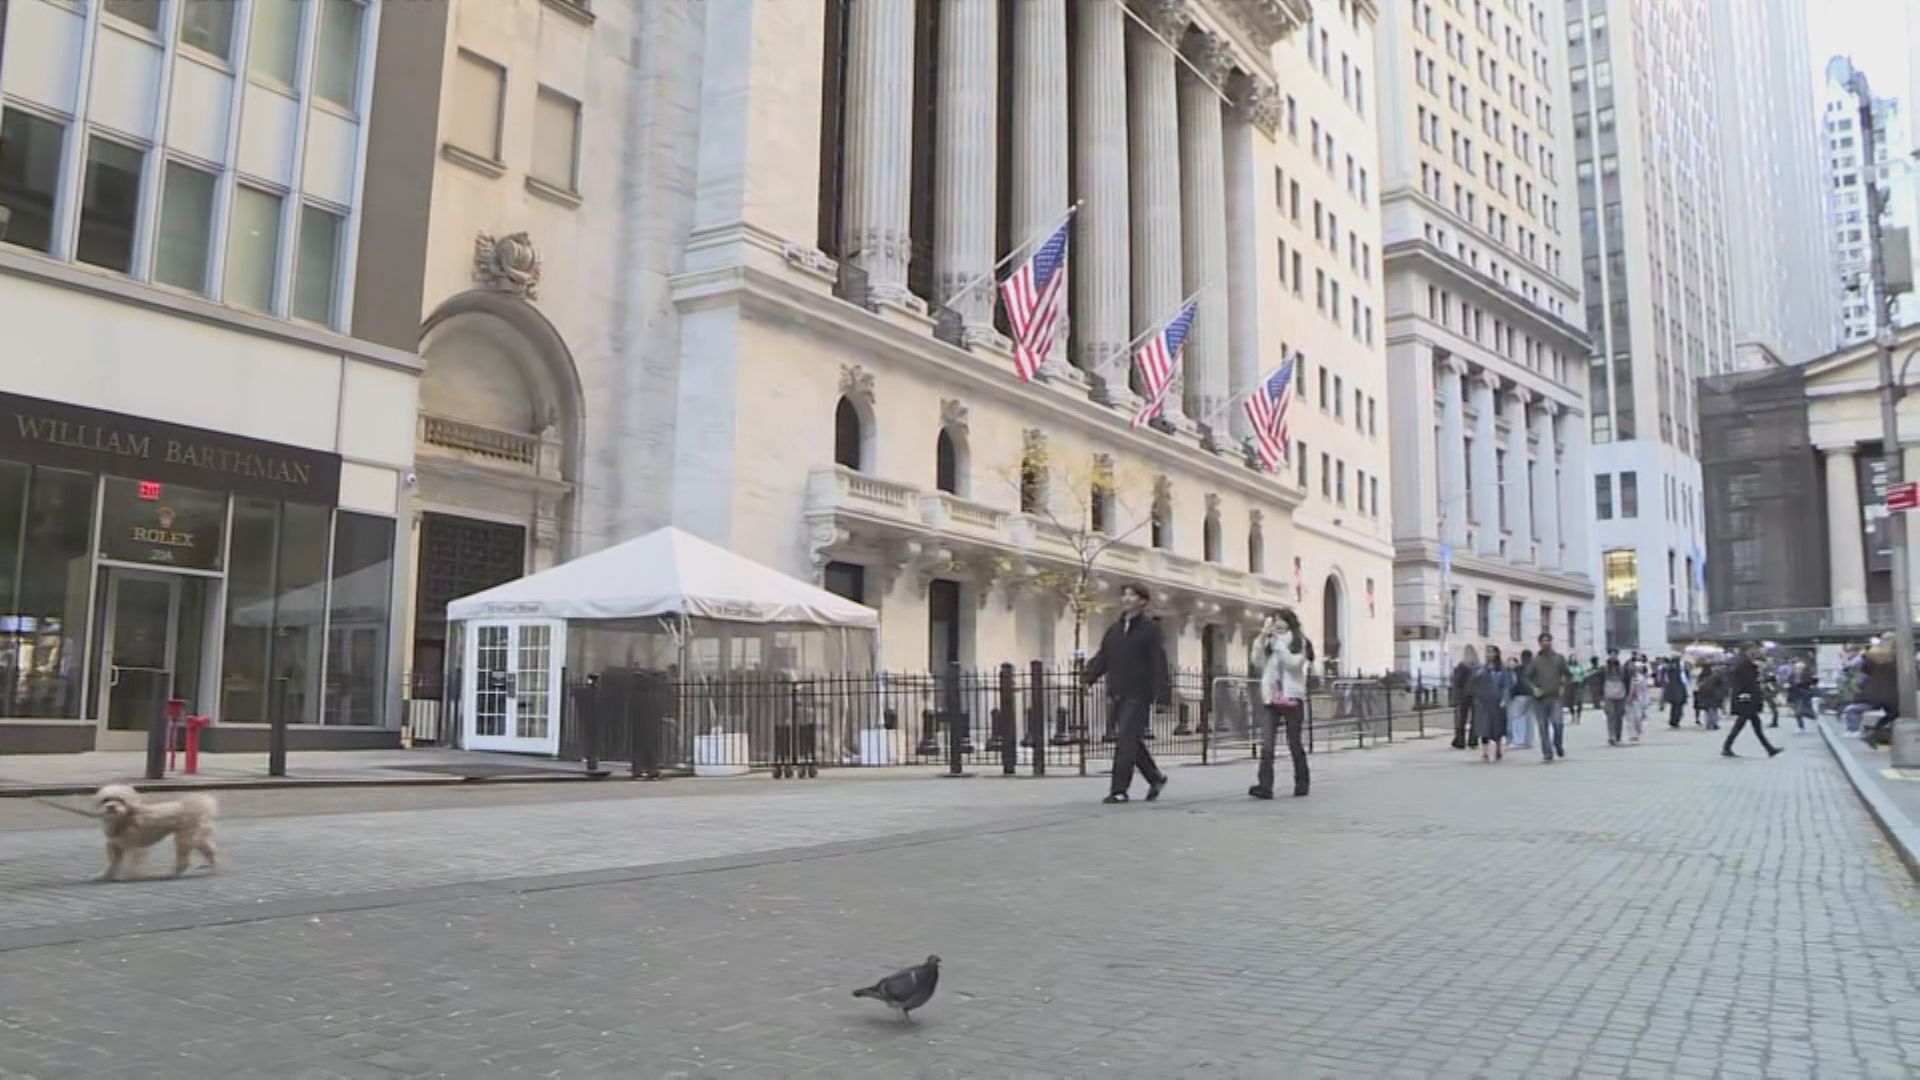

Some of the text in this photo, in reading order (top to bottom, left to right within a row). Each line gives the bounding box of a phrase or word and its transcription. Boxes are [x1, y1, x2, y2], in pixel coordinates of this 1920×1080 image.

[13, 412, 311, 484] WILLIAM BARTHMAN
[131, 527, 194, 547] ROLEX
